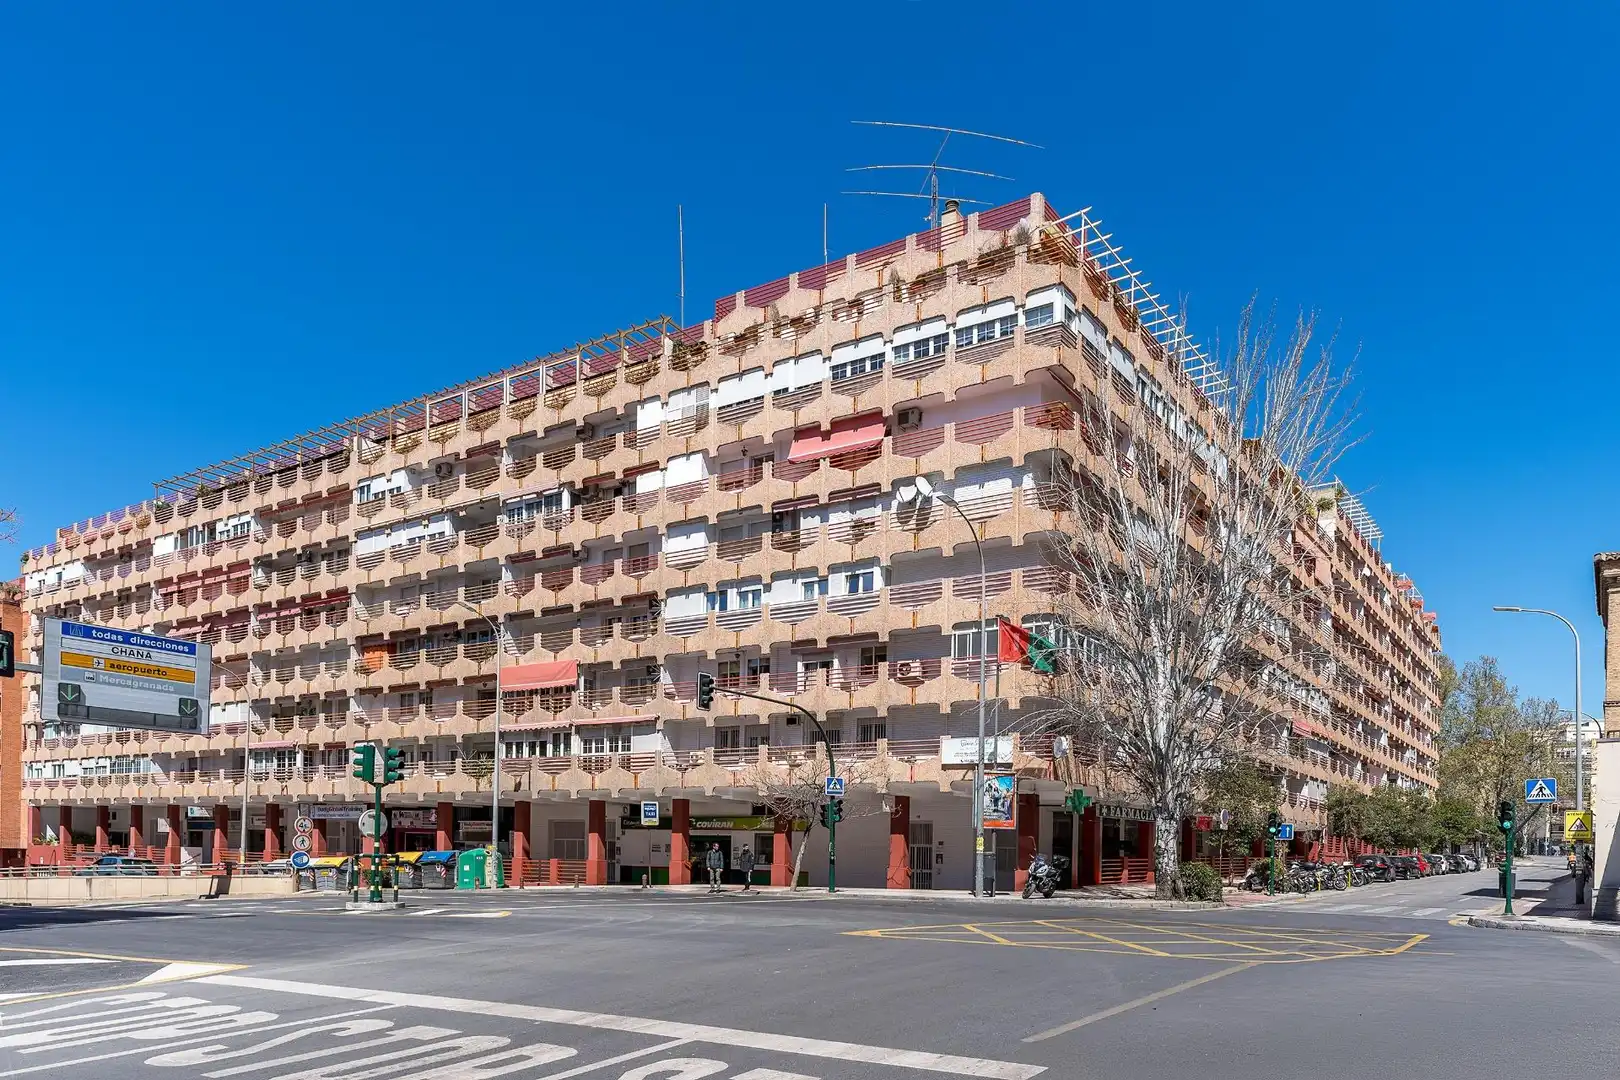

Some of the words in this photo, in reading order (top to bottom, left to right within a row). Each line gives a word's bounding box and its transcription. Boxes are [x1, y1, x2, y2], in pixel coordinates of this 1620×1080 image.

[91, 629, 124, 642] todas
[130, 634, 190, 653] direcciones
[111, 646, 153, 660] CHANA
[109, 661, 168, 677] aeropuerto
[99, 674, 175, 692] Mercagranada
[1110, 806, 1155, 821] FARMACIA
